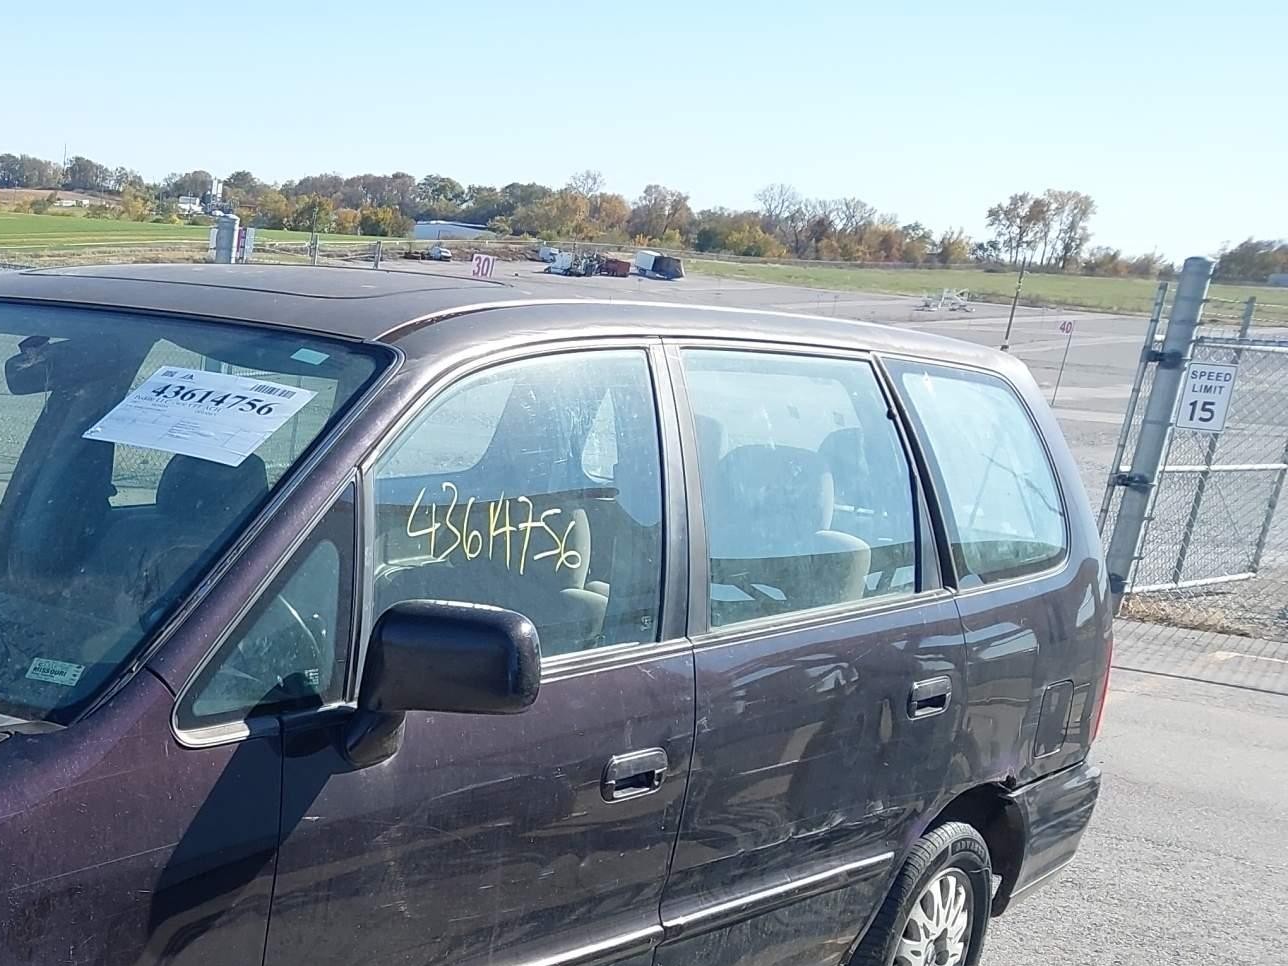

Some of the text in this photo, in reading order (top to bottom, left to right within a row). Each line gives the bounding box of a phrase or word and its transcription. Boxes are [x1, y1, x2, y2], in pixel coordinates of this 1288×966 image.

[473, 255, 491, 277] 30
[1059, 320, 1073, 334] 40
[1190, 369, 1232, 382] SPEED
[1191, 383, 1225, 395] LIMIT
[152, 383, 280, 416] 43614756
[1188, 400, 1216, 422] 15
[406, 481, 582, 575] 43614756
[32, 666, 68, 677] MISSOURI
